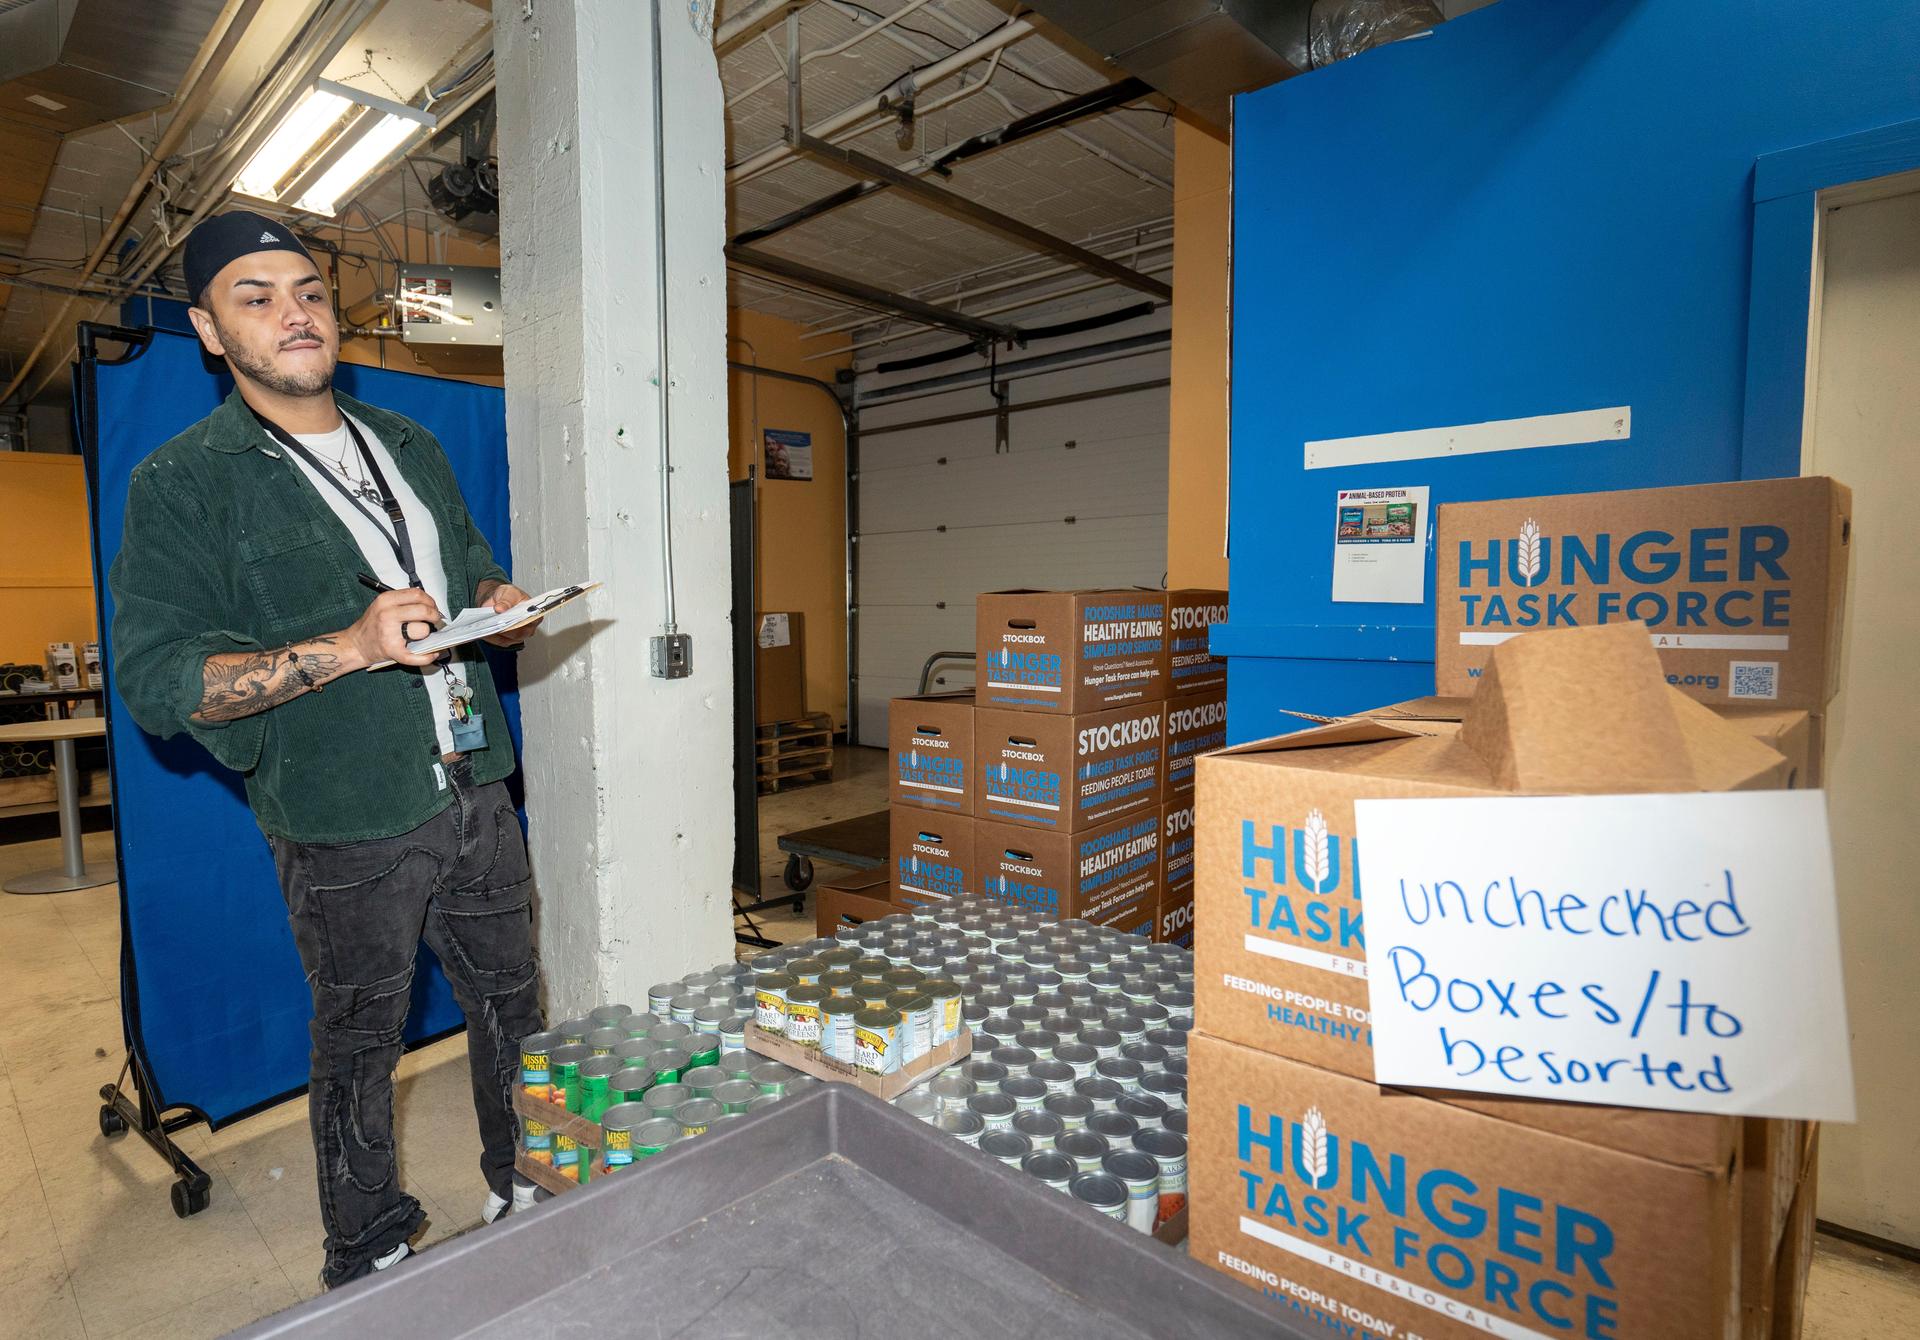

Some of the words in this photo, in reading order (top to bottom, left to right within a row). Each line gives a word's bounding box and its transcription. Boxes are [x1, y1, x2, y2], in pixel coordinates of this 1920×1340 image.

[1349, 491, 1384, 499] ANIMAL-BASED
[1386, 490, 1406, 498] PROTEIN
[1458, 525, 1791, 588] HUNGER
[1084, 605, 1135, 621] FOODSHARE
[1137, 604, 1163, 618] MAKES
[1460, 593, 1578, 627] TASK
[1597, 589, 1791, 628] FORCE
[1003, 634, 1045, 644] STOCKBOX
[1084, 622, 1129, 642] HEALTHY
[1130, 620, 1163, 639] EATING
[1083, 642, 1117, 660] SIMPLER
[1118, 640, 1132, 657] FOR
[1133, 639, 1162, 654] SENIORS
[986, 650, 1062, 672] HUNGER
[1172, 655, 1194, 667] FEEDING
[987, 669, 1016, 682] TASK
[1020, 671, 1062, 686] FORCE
[1084, 675, 1104, 687] Hunger
[1105, 673, 1117, 683] Task
[1117, 672, 1130, 682] Force
[1140, 670, 1150, 680] help
[912, 737, 949, 749] STOCKBOX
[1078, 714, 1160, 756] STOCKBOX
[899, 752, 963, 775] HUNGER
[1002, 750, 1044, 762] STOCKBOX
[1079, 759, 1114, 781] HUNGER
[1115, 755, 1134, 771] TASK
[1135, 748, 1159, 765] FORCE
[1170, 756, 1193, 770] FEEDING
[900, 768, 925, 782] TASK
[928, 772, 963, 788] FORCE
[986, 761, 1060, 789] HUNGER
[1081, 778, 1111, 796] FEEDING
[1111, 772, 1134, 788] PEOPLE
[1135, 766, 1156, 780] TODAY.
[987, 782, 1015, 797] TASK
[1018, 786, 1060, 804] FORCE
[1080, 827, 1130, 857] FOODSHARE
[1131, 817, 1158, 837] MAKES
[912, 843, 949, 858] STOCKBOX
[1080, 845, 1125, 877] HEALTHY
[1125, 832, 1158, 859] EATING
[900, 856, 963, 884] HUNGER
[1000, 862, 1042, 877] STOCKBOX
[1080, 868, 1112, 894] SIMPLER
[1114, 862, 1128, 880] FOR
[1128, 850, 1157, 873] SENIORS
[1168, 854, 1190, 871] FEEDING
[900, 872, 925, 889] TASK
[985, 876, 1058, 904] HUNGER
[1081, 904, 1101, 919] Hunger
[1101, 898, 1112, 909] Task
[1112, 893, 1125, 905] Force
[1126, 889, 1134, 898] can
[1134, 883, 1145, 895] help
[1243, 887, 1366, 949] TASK
[1223, 973, 1283, 1000] FEEDING
[1285, 989, 1342, 1016] PEOPLE
[1267, 1003, 1361, 1043] HEALTHY
[522, 1053, 548, 1066] MISSIO
[1237, 1103, 1615, 1289] HUNGER
[1238, 1170, 1373, 1257] TASK
[1394, 1226, 1619, 1340] FORCE
[1218, 1251, 1279, 1287] FEEDING
[1280, 1277, 1337, 1313] PEOPLE
[1340, 1302, 1396, 1337] TODAY
